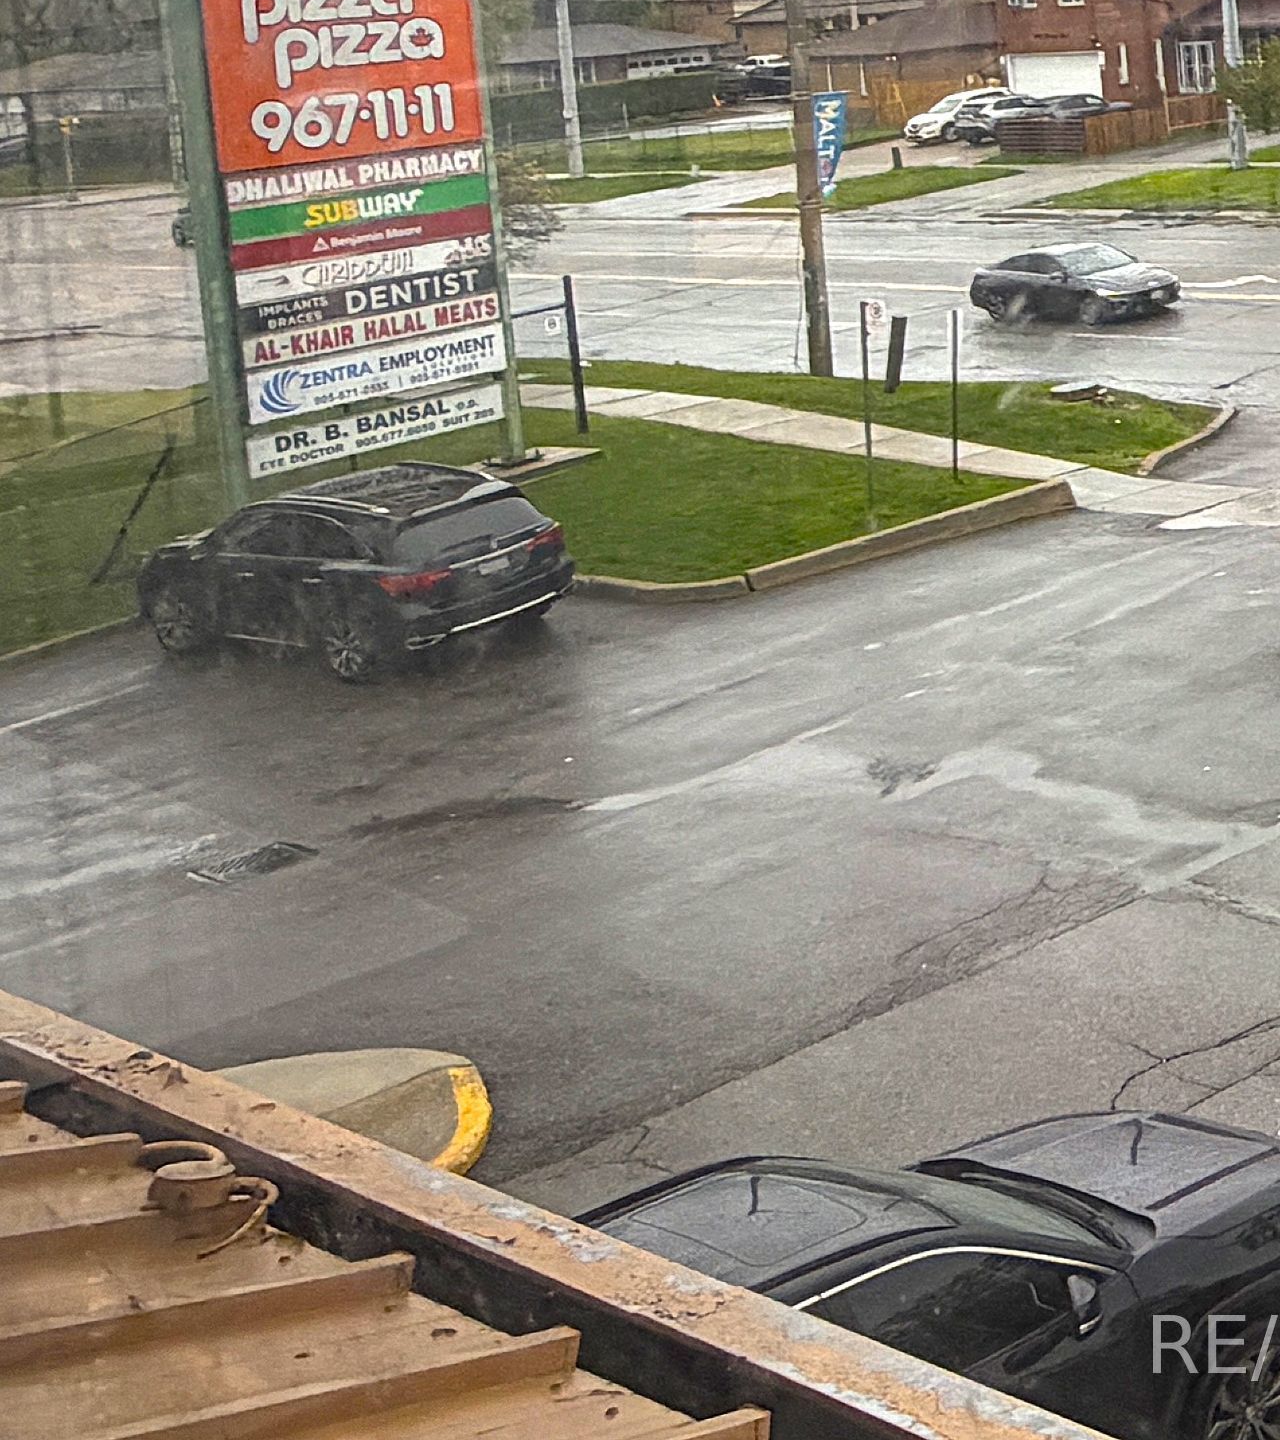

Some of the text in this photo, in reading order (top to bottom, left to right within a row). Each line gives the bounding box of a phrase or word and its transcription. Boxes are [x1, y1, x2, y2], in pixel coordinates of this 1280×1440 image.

[274, 17, 444, 89] pizza
[227, 148, 483, 203] DHALIWAL PHARMACY
[304, 189, 424, 228] SUBWAY
[258, 296, 329, 318] IMPLANTS
[345, 268, 479, 315] DENTIST
[254, 297, 497, 363] AL-KHAIR HALAL MEATS
[300, 334, 496, 389] ZENTRA EMPLOYMENT
[275, 431, 317, 453] DR.
[325, 424, 349, 441] B.
[356, 399, 450, 433] BANSAL
[290, 443, 344, 464] DOCTOR
